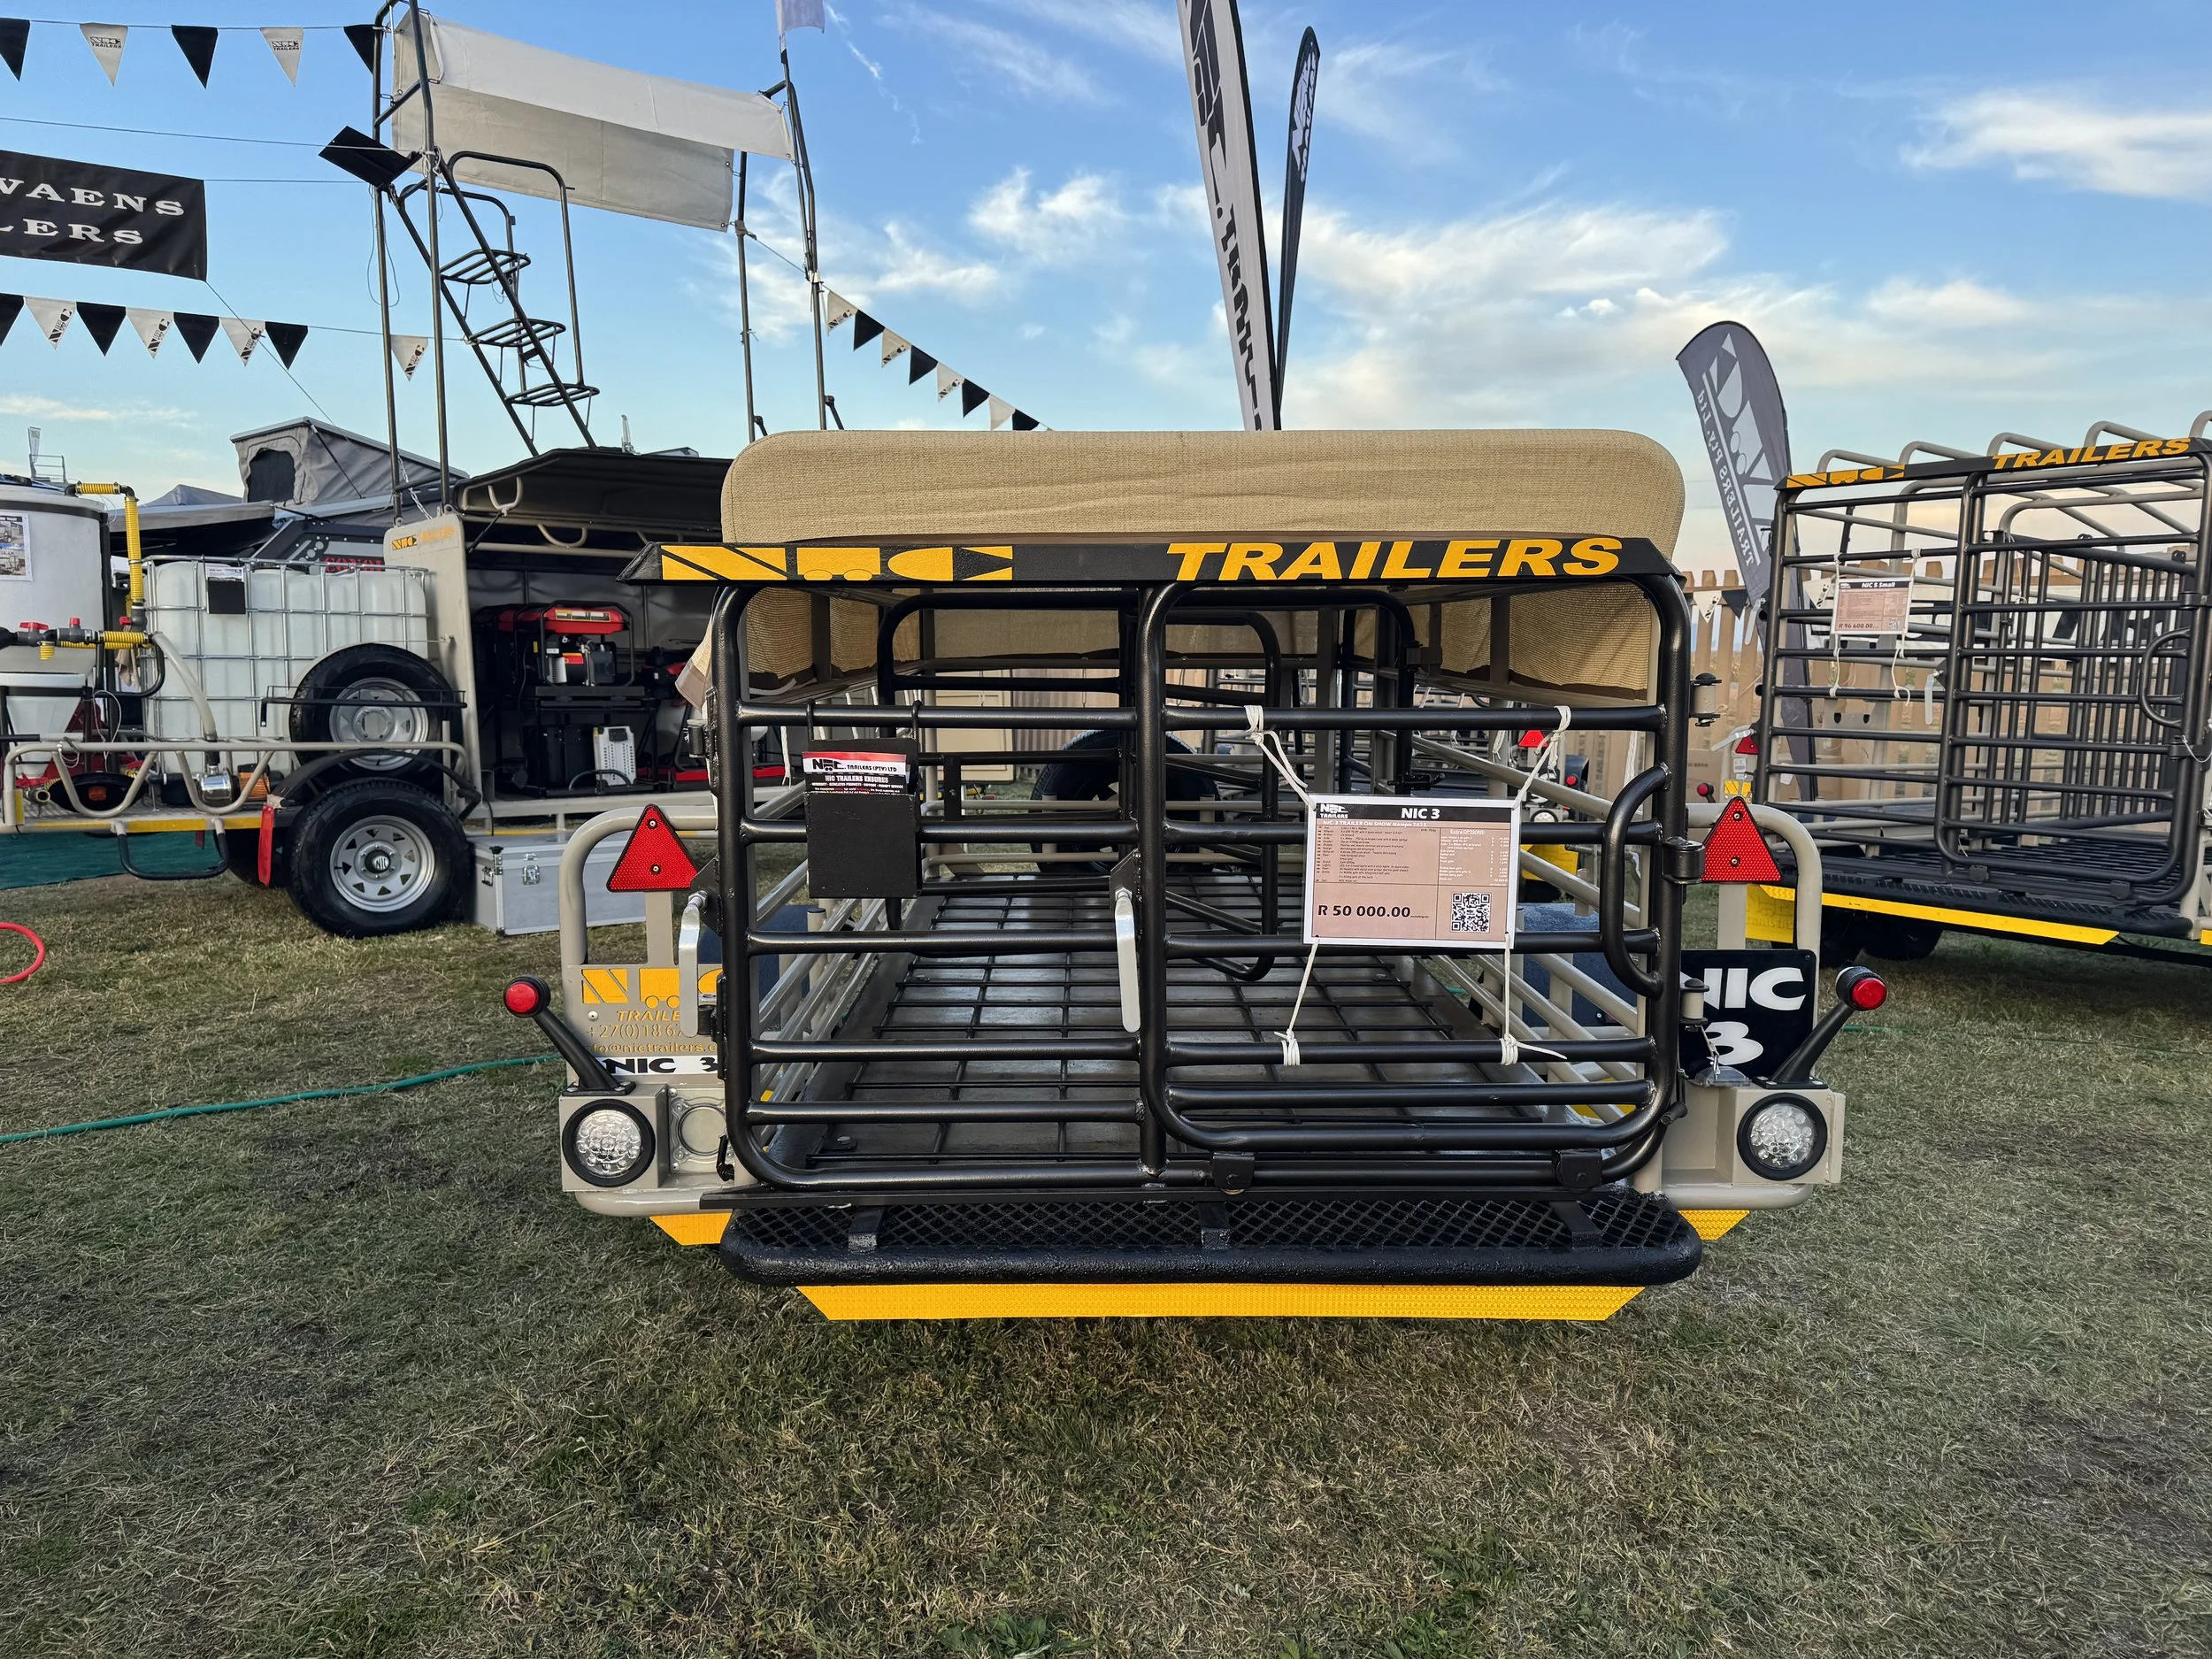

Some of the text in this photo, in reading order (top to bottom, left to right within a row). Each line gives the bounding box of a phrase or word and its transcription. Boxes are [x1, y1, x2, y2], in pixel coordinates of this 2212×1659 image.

[1992, 436, 2193, 470] TRAILERS
[1167, 538, 1623, 581] TRAILERS
[1401, 808, 1427, 819] NIC
[1431, 808, 1440, 819] 3
[1317, 904, 1410, 918] R 50 000.00
[602, 1056, 718, 1074] NIC 3
